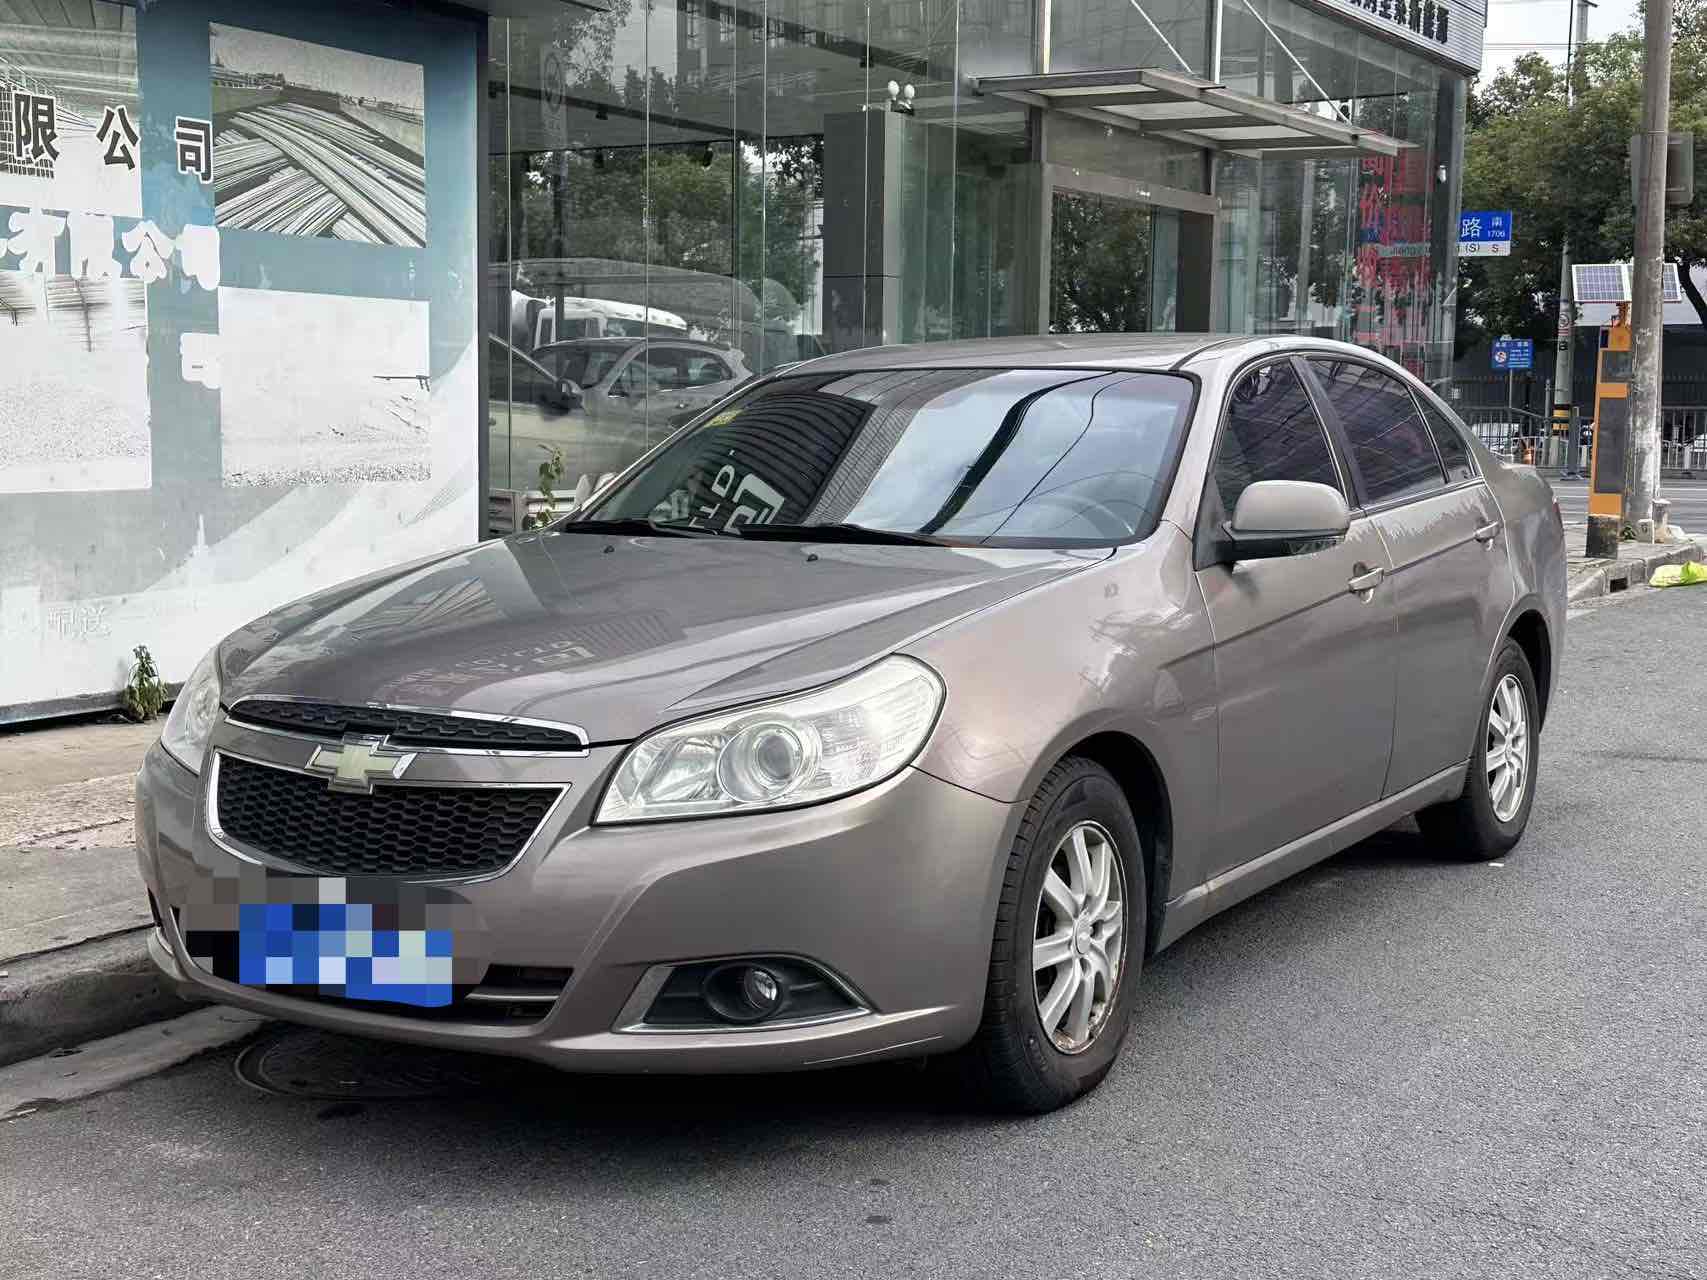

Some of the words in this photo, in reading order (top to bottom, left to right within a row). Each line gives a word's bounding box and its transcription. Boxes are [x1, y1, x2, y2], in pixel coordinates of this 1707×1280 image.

[12, 92, 214, 184] 限公司
[1461, 217, 1483, 240] 路
